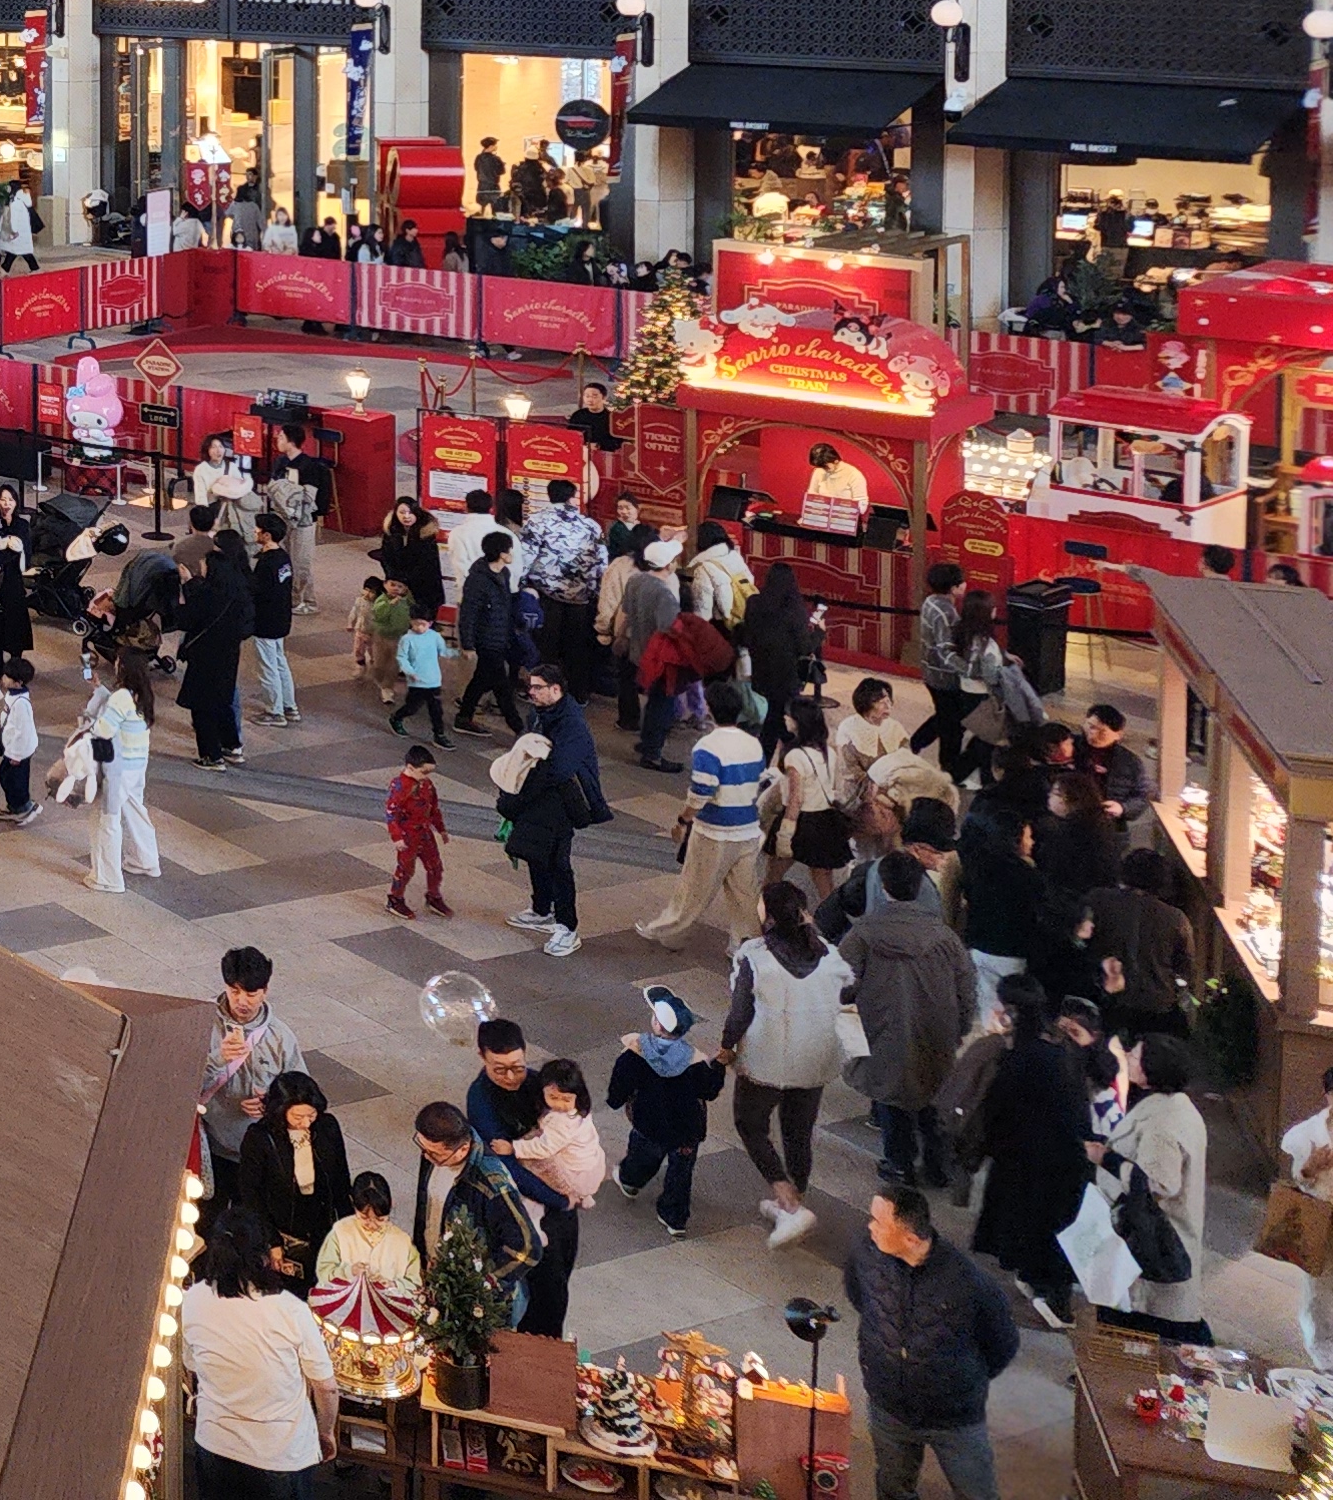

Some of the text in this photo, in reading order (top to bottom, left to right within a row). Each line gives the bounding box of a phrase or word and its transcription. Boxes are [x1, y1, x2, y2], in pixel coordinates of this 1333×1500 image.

[503, 299, 596, 332] Sanrio characters
[719, 337, 902, 404] Sanrio characters
[769, 364, 847, 382] CHRISTMAS
[788, 377, 829, 393] TRAIN
[643, 432, 681, 444] TICKET
[644, 442, 681, 454] OFFICE
